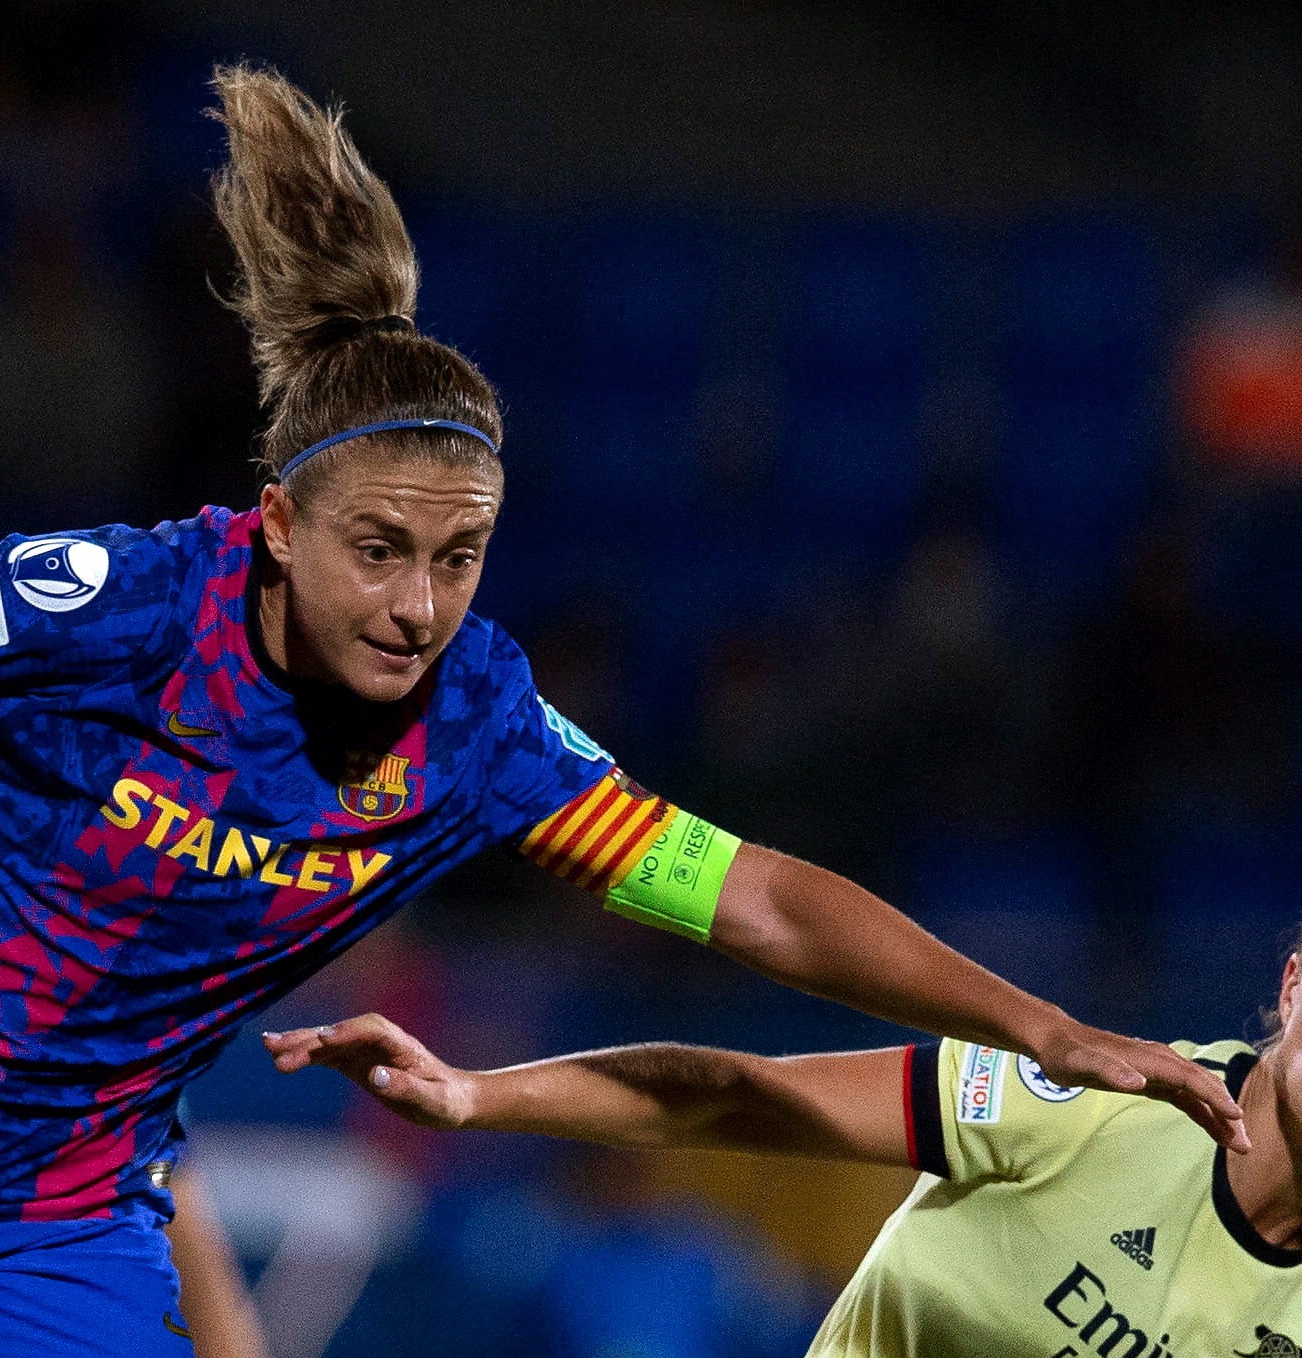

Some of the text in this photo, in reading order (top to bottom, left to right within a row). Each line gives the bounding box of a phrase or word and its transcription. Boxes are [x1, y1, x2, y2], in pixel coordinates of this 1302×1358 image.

[99, 777, 392, 895] STANLEY
[637, 855, 659, 886] NO
[1110, 1233, 1154, 1271] adidas
